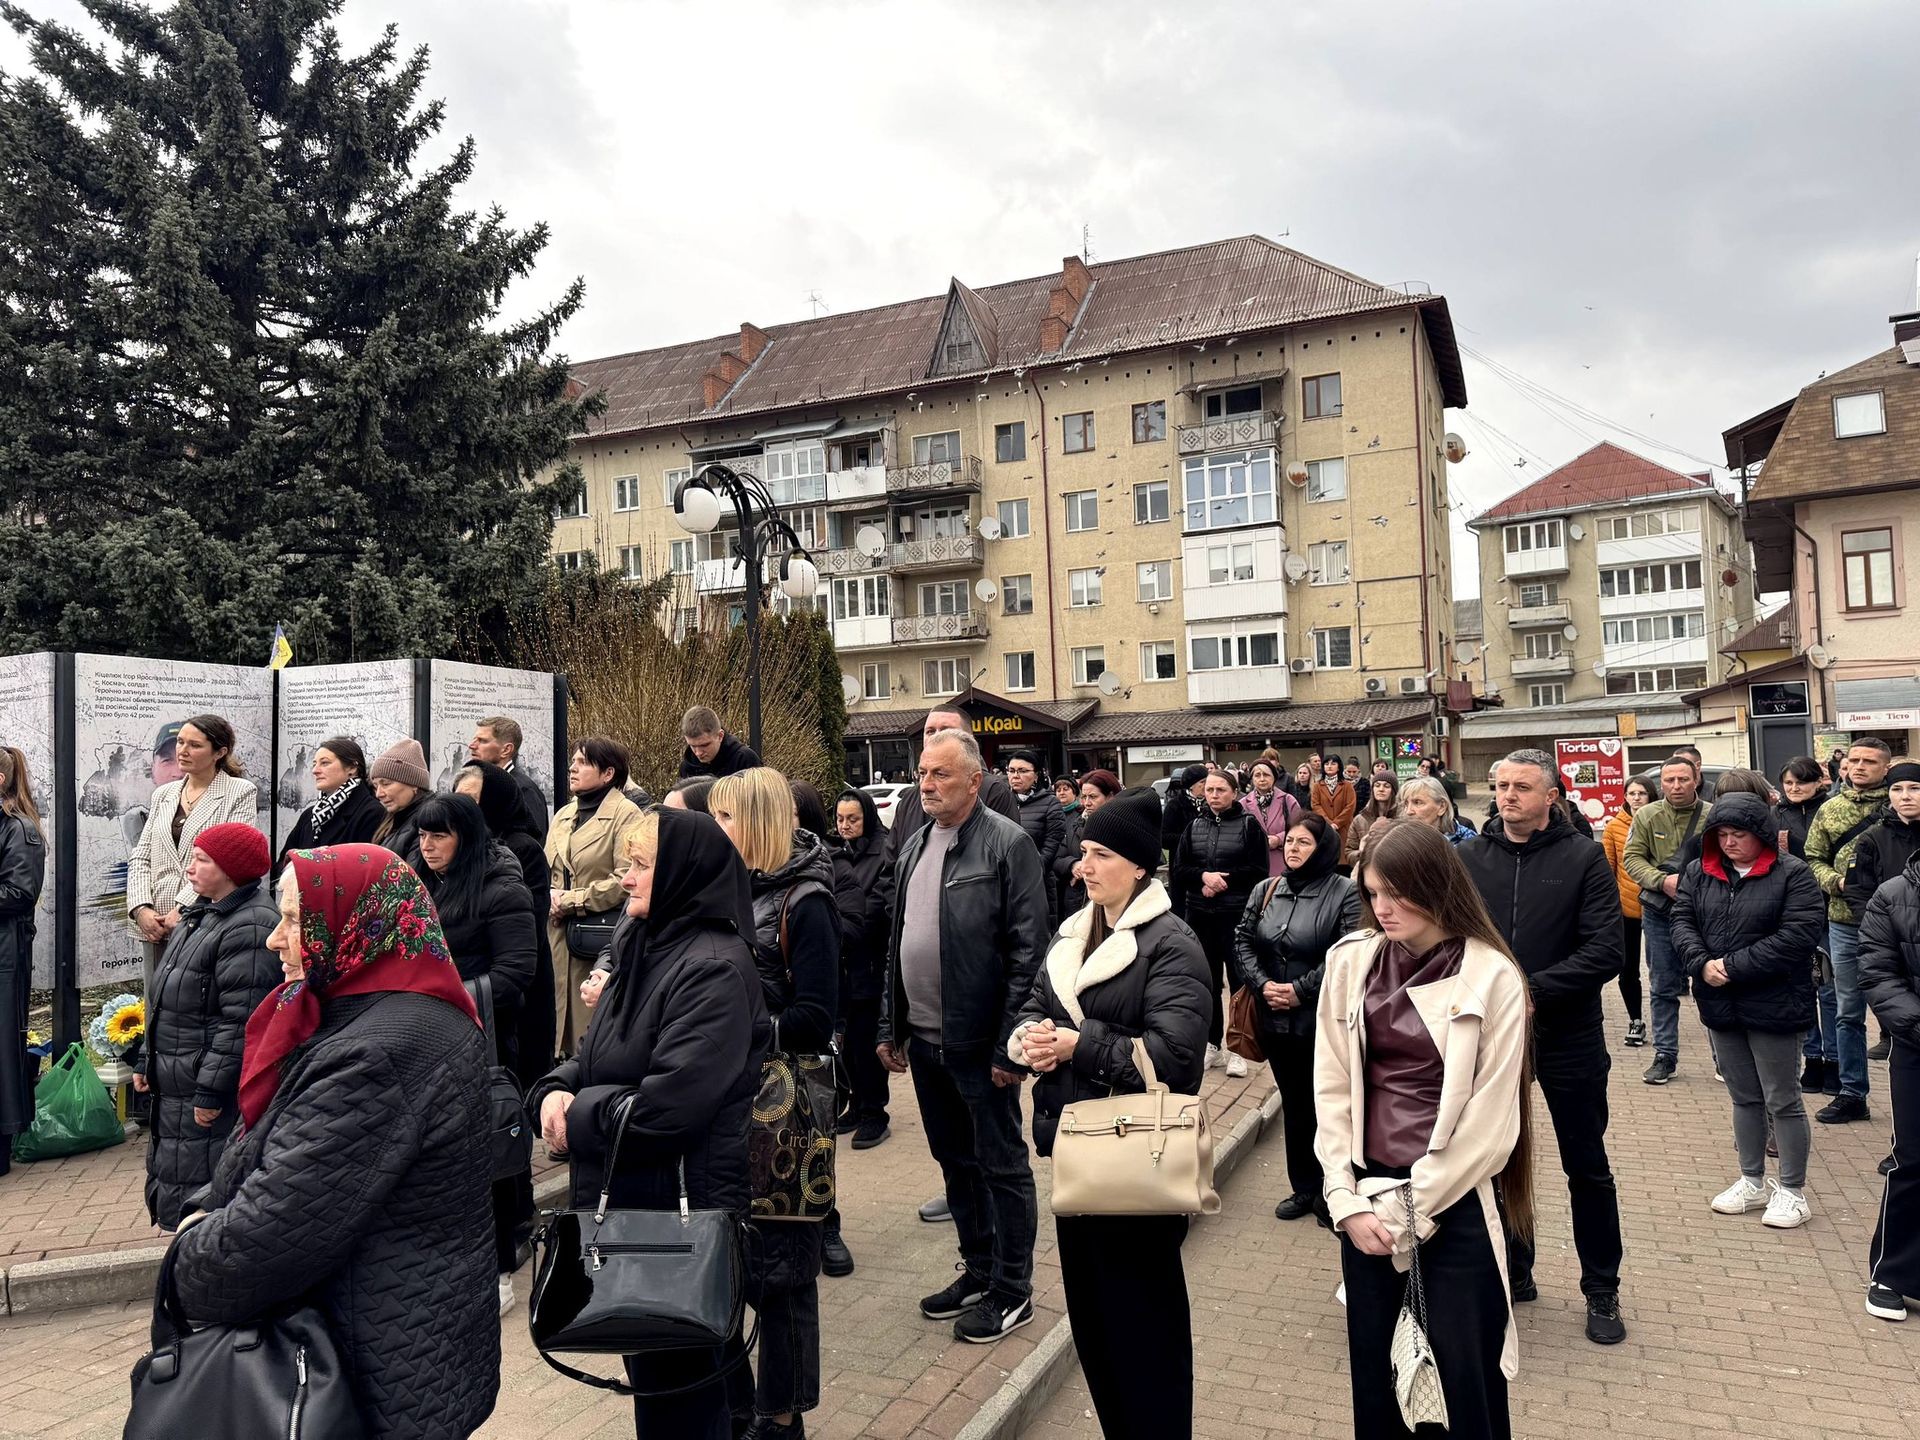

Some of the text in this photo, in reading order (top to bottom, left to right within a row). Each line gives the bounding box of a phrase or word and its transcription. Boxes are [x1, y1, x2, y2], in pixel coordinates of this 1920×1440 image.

[95, 687, 121, 695] Героїчно
[95, 695, 131, 703] Запорізької
[105, 703, 138, 711] російської
[1773, 703, 1787, 713] XS
[114, 711, 128, 719] було
[1849, 711, 1911, 722] Диво Тісто
[984, 715, 1023, 735] Край
[1558, 742, 1598, 753] Torba
[101, 956, 130, 970] Герой
[777, 1127, 816, 1149] Circle
